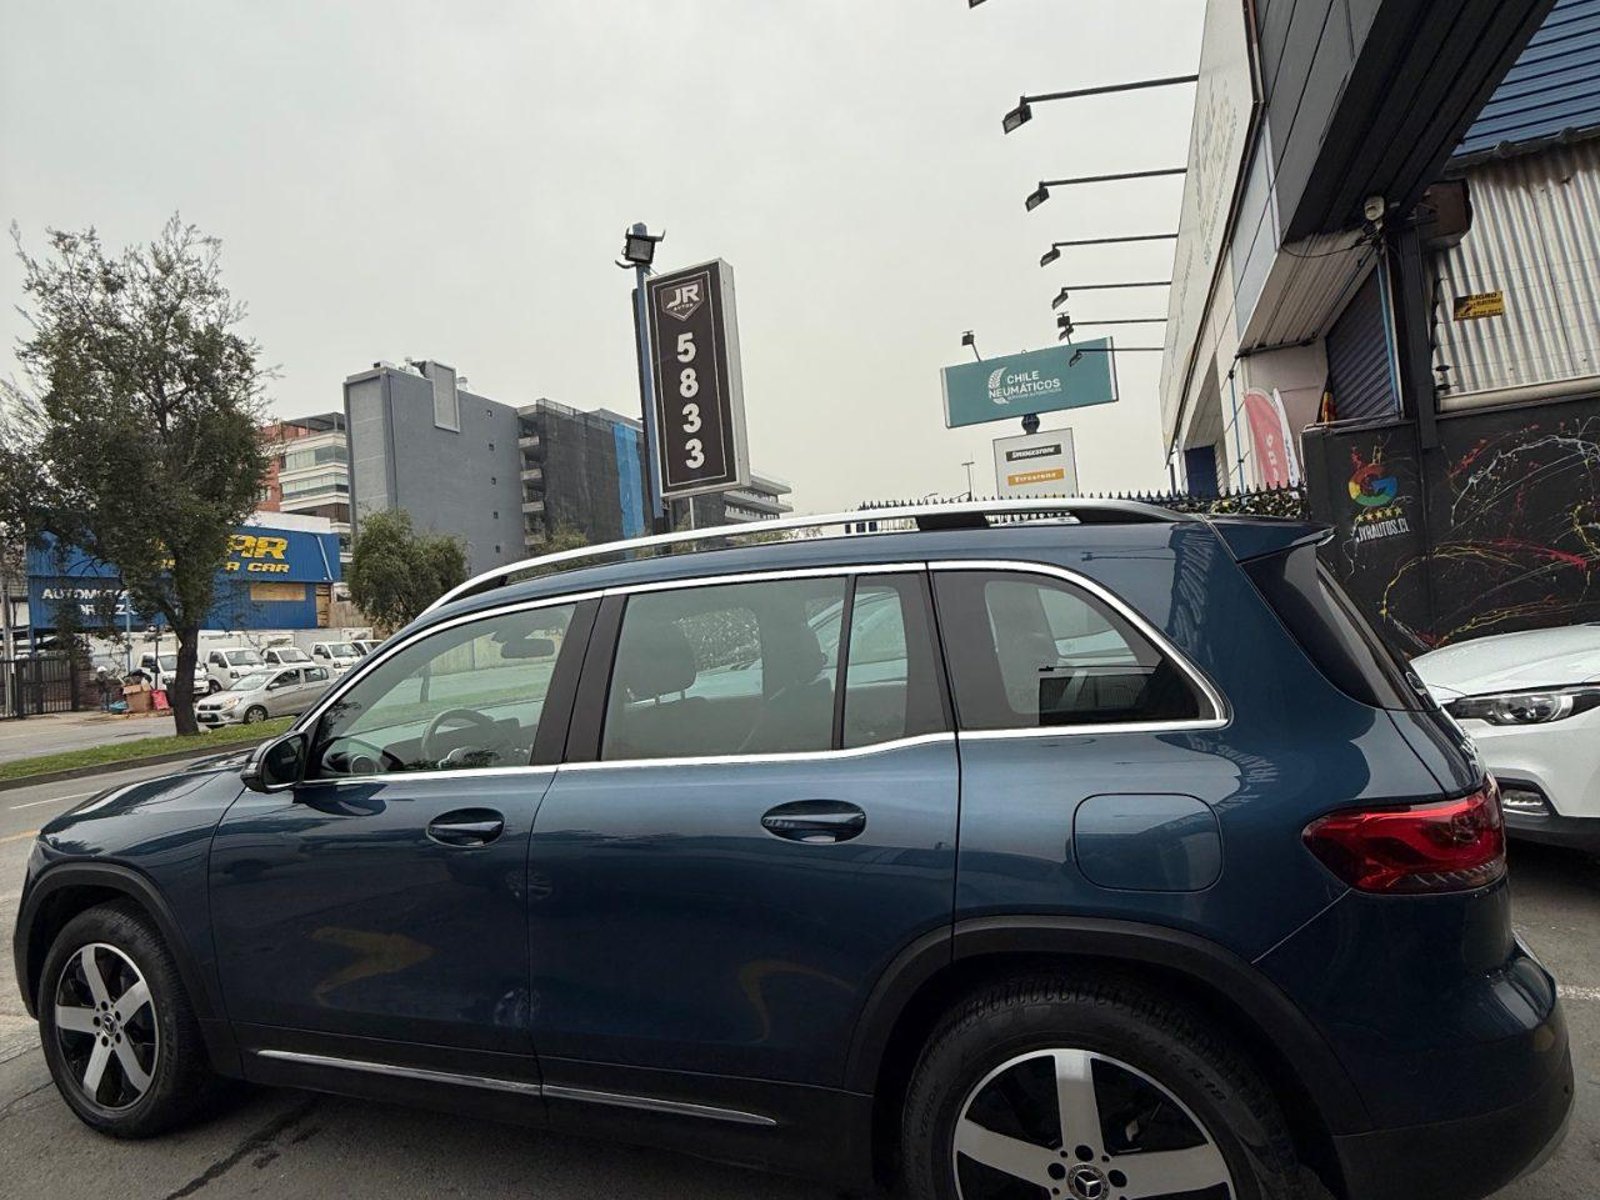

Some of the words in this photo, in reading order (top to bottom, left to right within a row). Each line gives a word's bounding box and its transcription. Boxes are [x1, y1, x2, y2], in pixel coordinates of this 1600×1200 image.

[666, 284, 700, 309] JR
[1007, 370, 1040, 385] CHILE
[988, 378, 1061, 399] NEUMÁTICOS
[247, 562, 290, 573] CAR
